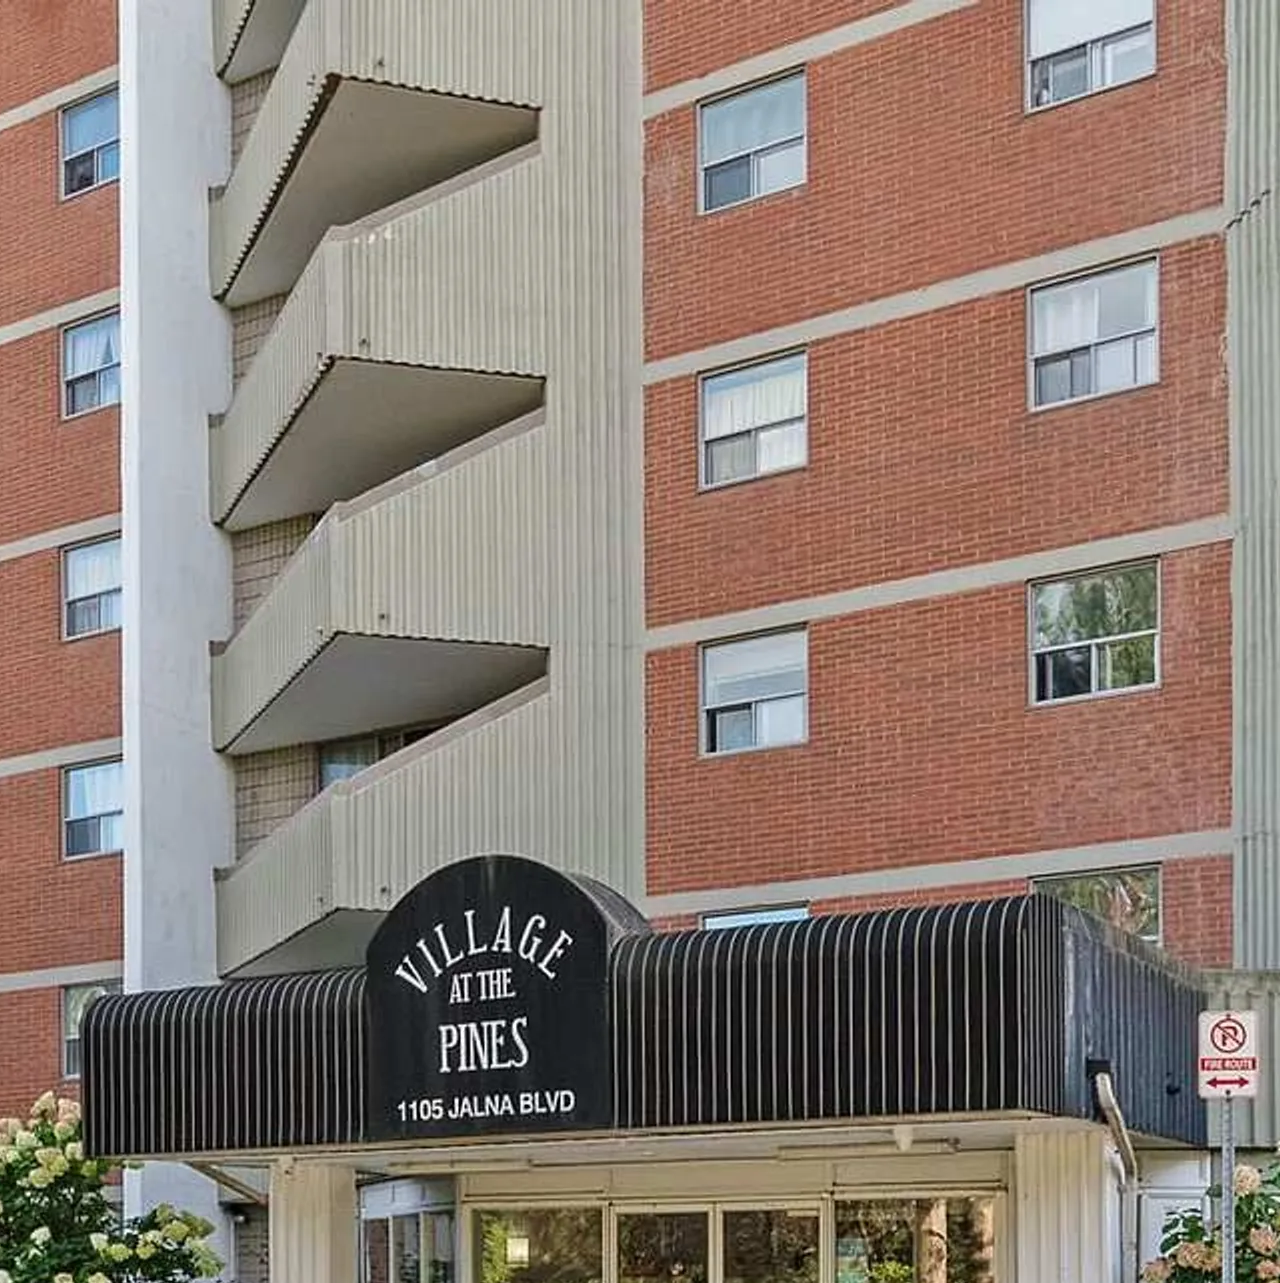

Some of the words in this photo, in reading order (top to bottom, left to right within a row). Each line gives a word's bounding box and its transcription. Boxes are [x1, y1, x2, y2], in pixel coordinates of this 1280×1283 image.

[395, 906, 573, 993] VILLAGE
[449, 973, 473, 1003] AT
[476, 968, 516, 1000] THE
[438, 1016, 529, 1073] PINES
[397, 1099, 444, 1121] 1105
[447, 1094, 514, 1119] JALNA
[519, 1089, 575, 1115] BLVD
